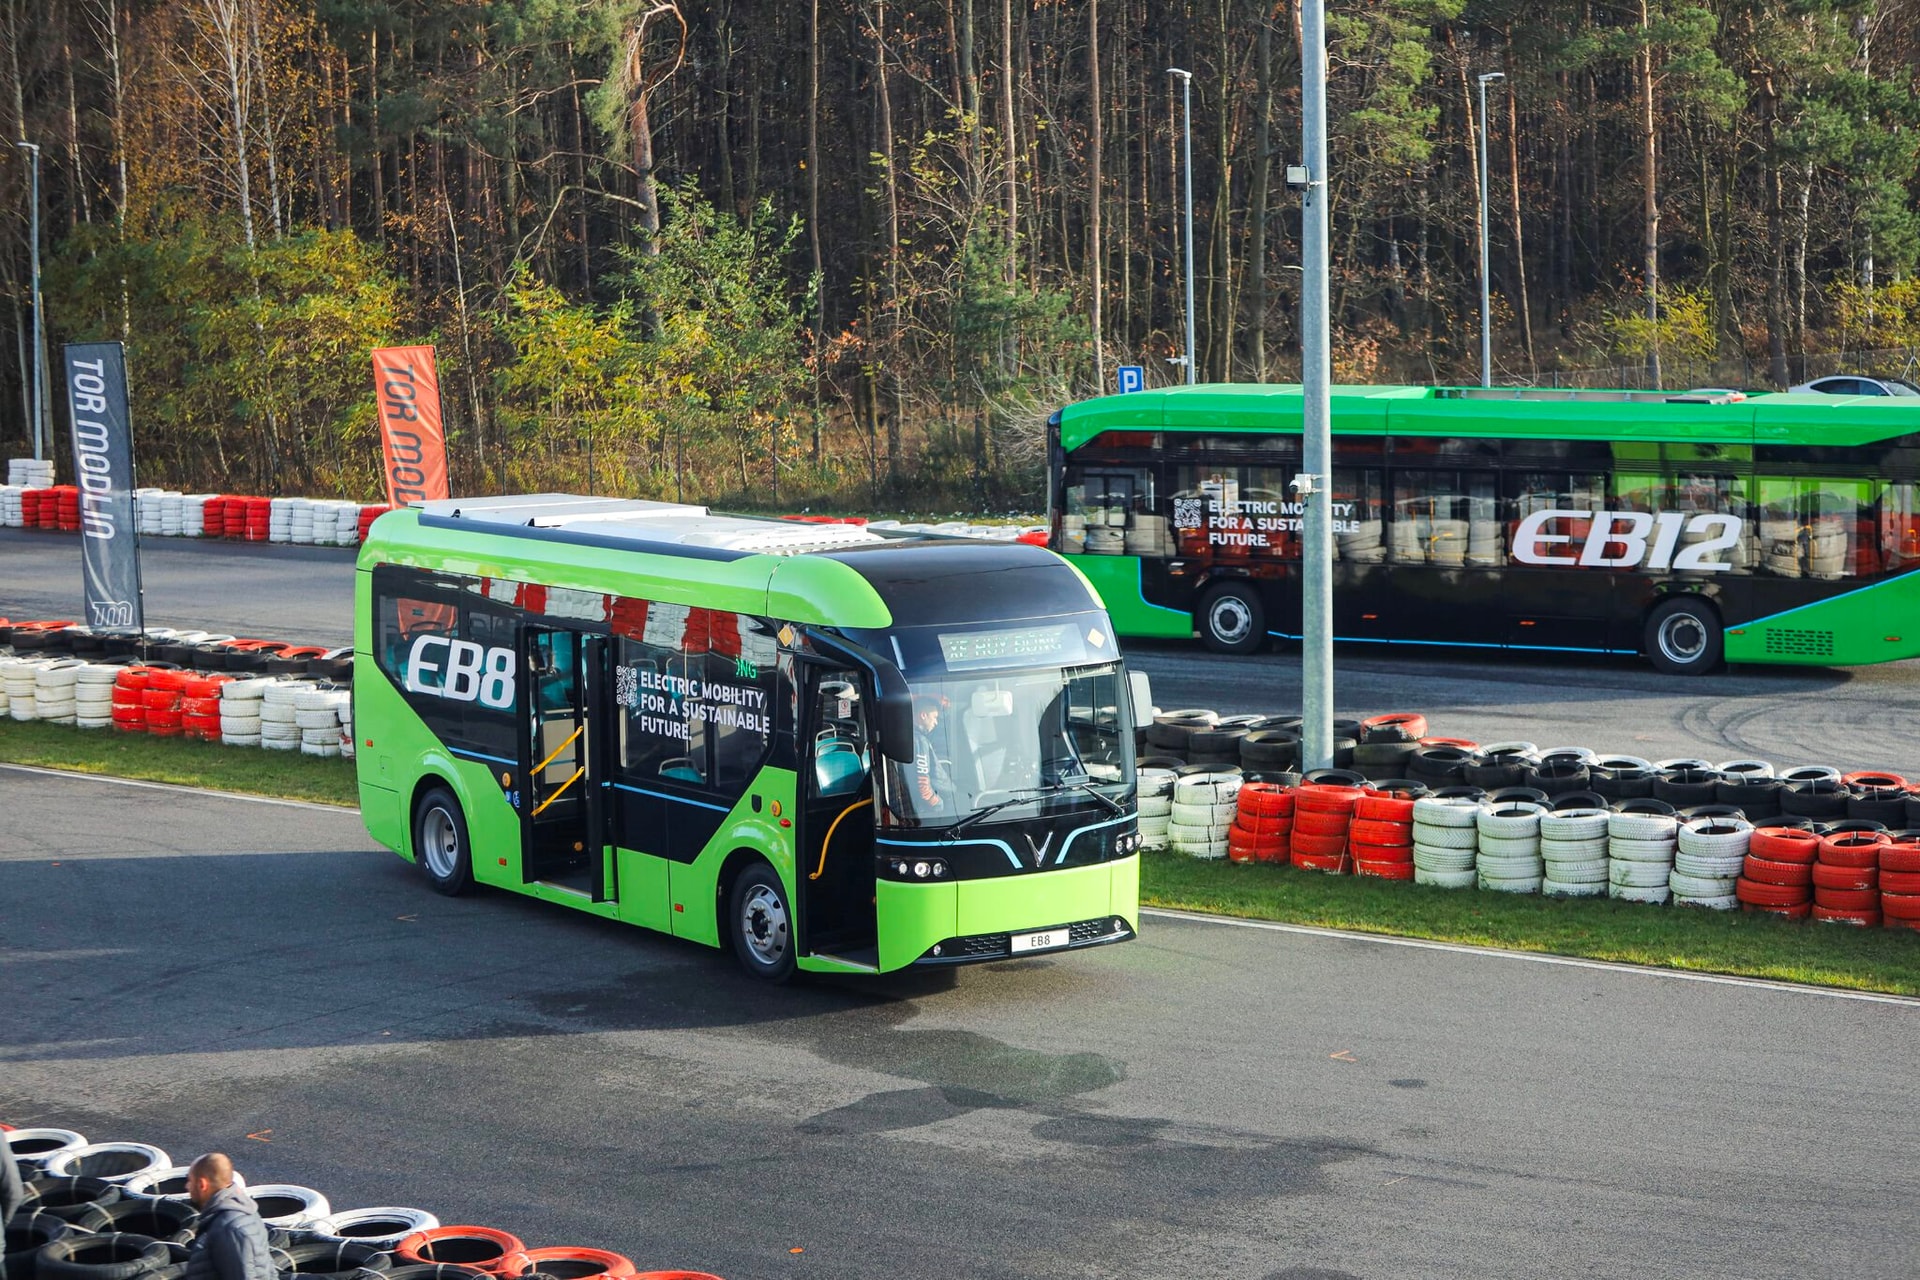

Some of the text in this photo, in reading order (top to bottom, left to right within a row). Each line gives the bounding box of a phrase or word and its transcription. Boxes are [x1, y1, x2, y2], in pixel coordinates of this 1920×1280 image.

[72, 359, 106, 413] TOR
[383, 364, 418, 422] TOR
[1123, 370, 1138, 393] P
[1208, 500, 1352, 517] ELECTRIC MOTY
[1209, 517, 1360, 533] FOR A SUSTABLE
[1209, 532, 1271, 547] FUTURE.
[1512, 509, 1743, 571] EB12
[407, 634, 516, 709] EB8
[640, 670, 764, 709] ELECTRIC MOBILITY
[641, 693, 770, 734] FOR A SUSTAINABLE
[641, 715, 692, 741] FUTURE.
[916, 754, 929, 774] TOR
[1031, 934, 1050, 947] EB8
